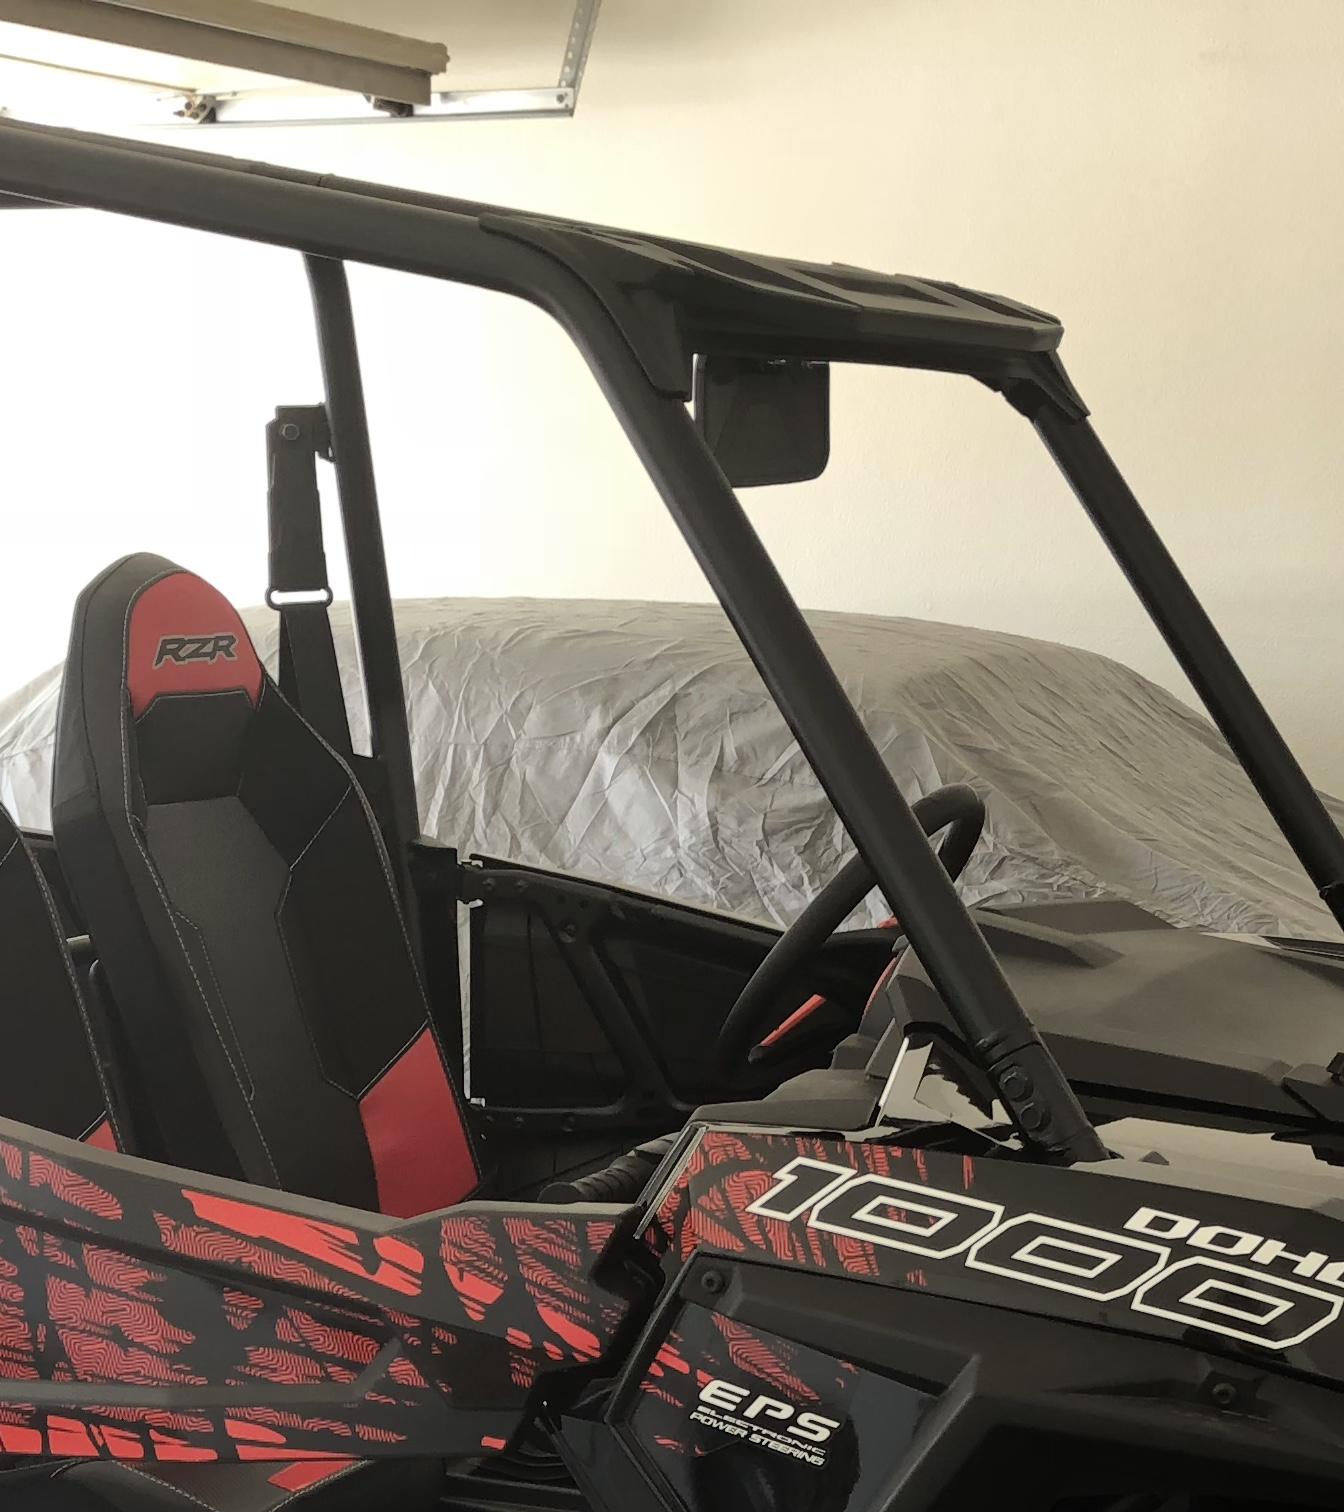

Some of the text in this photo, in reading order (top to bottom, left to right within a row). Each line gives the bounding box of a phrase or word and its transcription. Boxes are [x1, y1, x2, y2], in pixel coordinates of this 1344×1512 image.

[152, 632, 239, 669] RZR
[696, 1404, 827, 1457] ELECTRONIC
[698, 1378, 841, 1443] EPS
[689, 1411, 826, 1467] POWER STEERING
